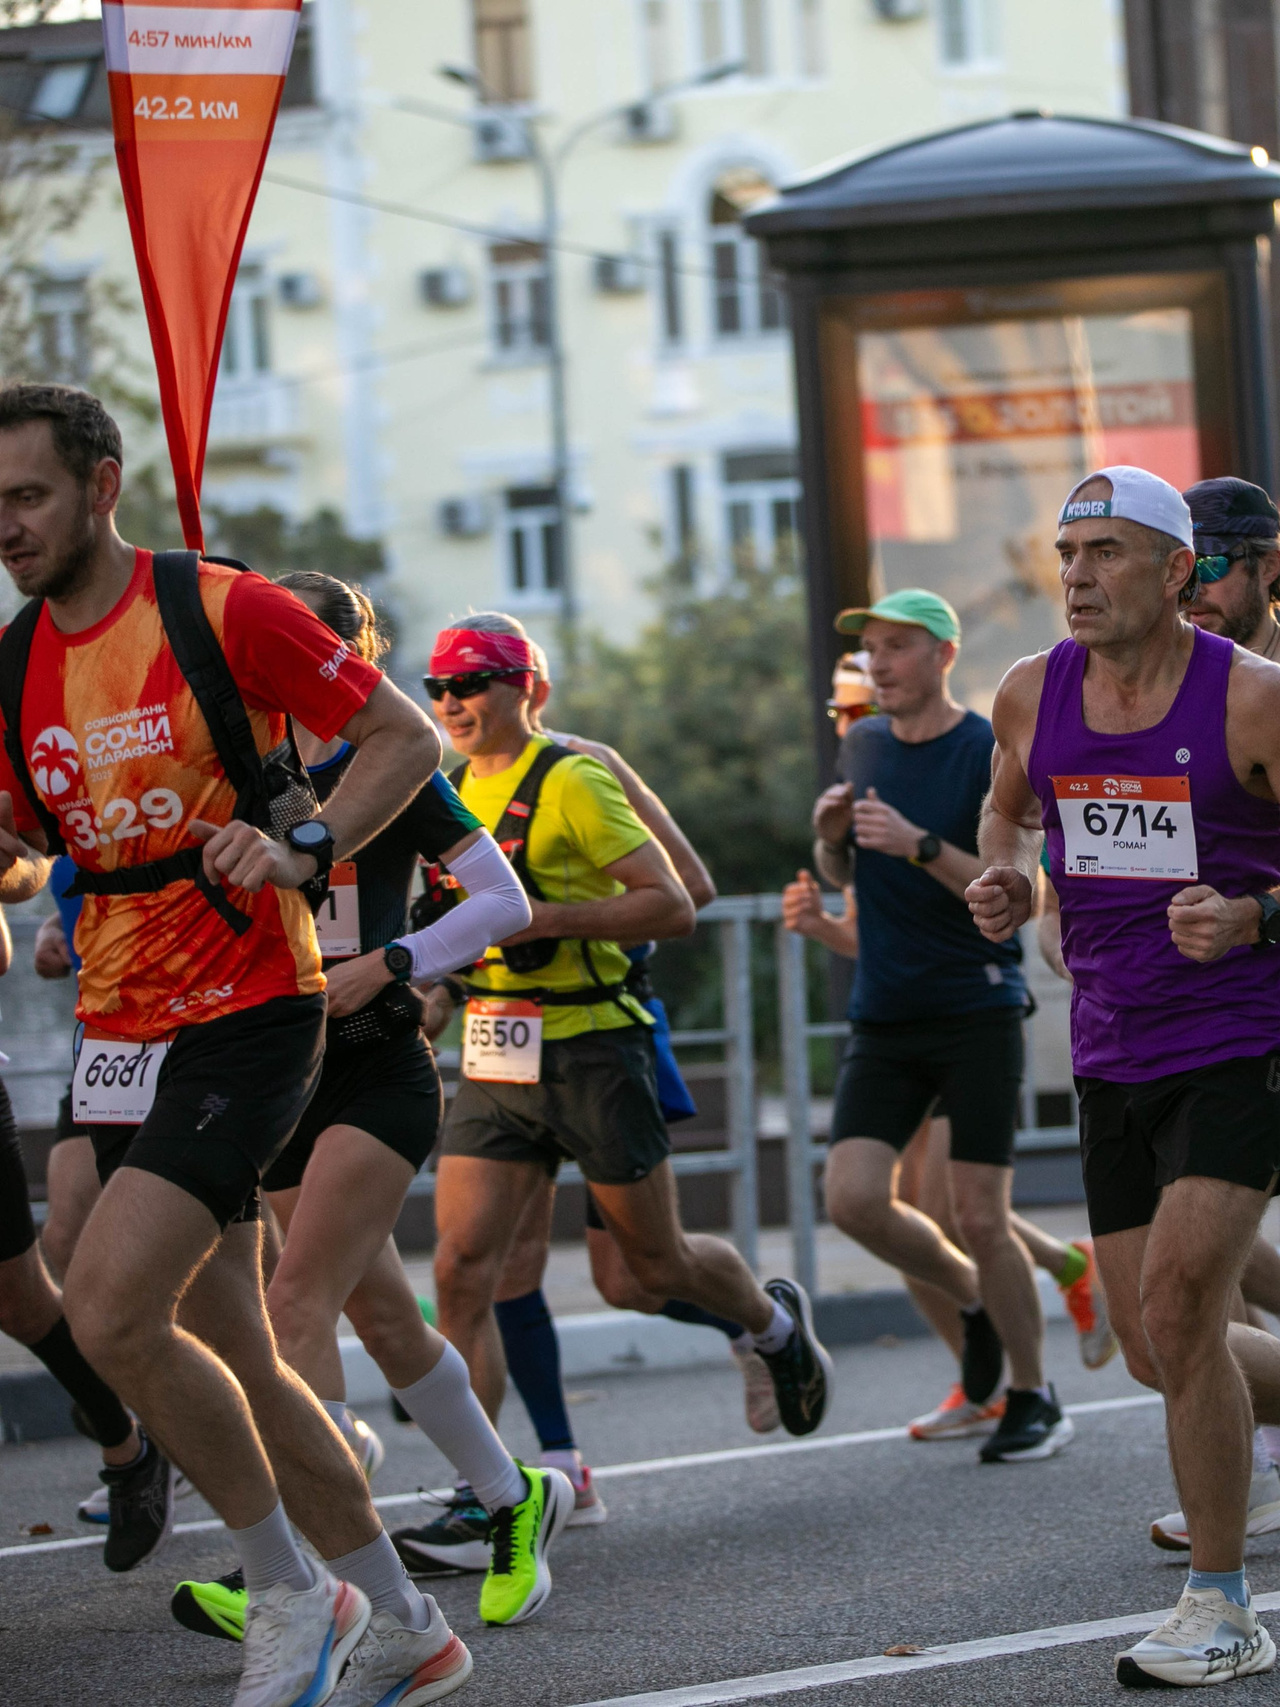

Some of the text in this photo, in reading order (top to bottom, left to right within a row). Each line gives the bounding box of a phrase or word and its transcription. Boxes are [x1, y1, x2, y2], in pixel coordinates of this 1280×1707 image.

[128, 29, 252, 49] 4:57 мин/км
[133, 96, 239, 120] 42.2 км
[84, 702, 167, 731] СОВКОМБАНК
[85, 715, 171, 755] СОЧИ
[87, 738, 174, 770] МАРАФОН
[1069, 783, 1089, 791] 42.2
[66, 787, 183, 850] 3:29
[1083, 802, 1177, 838] 6714
[1113, 841, 1147, 850] РОМАН
[1079, 861, 1087, 873] B
[471, 1019, 530, 1049] 6550
[85, 1053, 153, 1087] 6681
